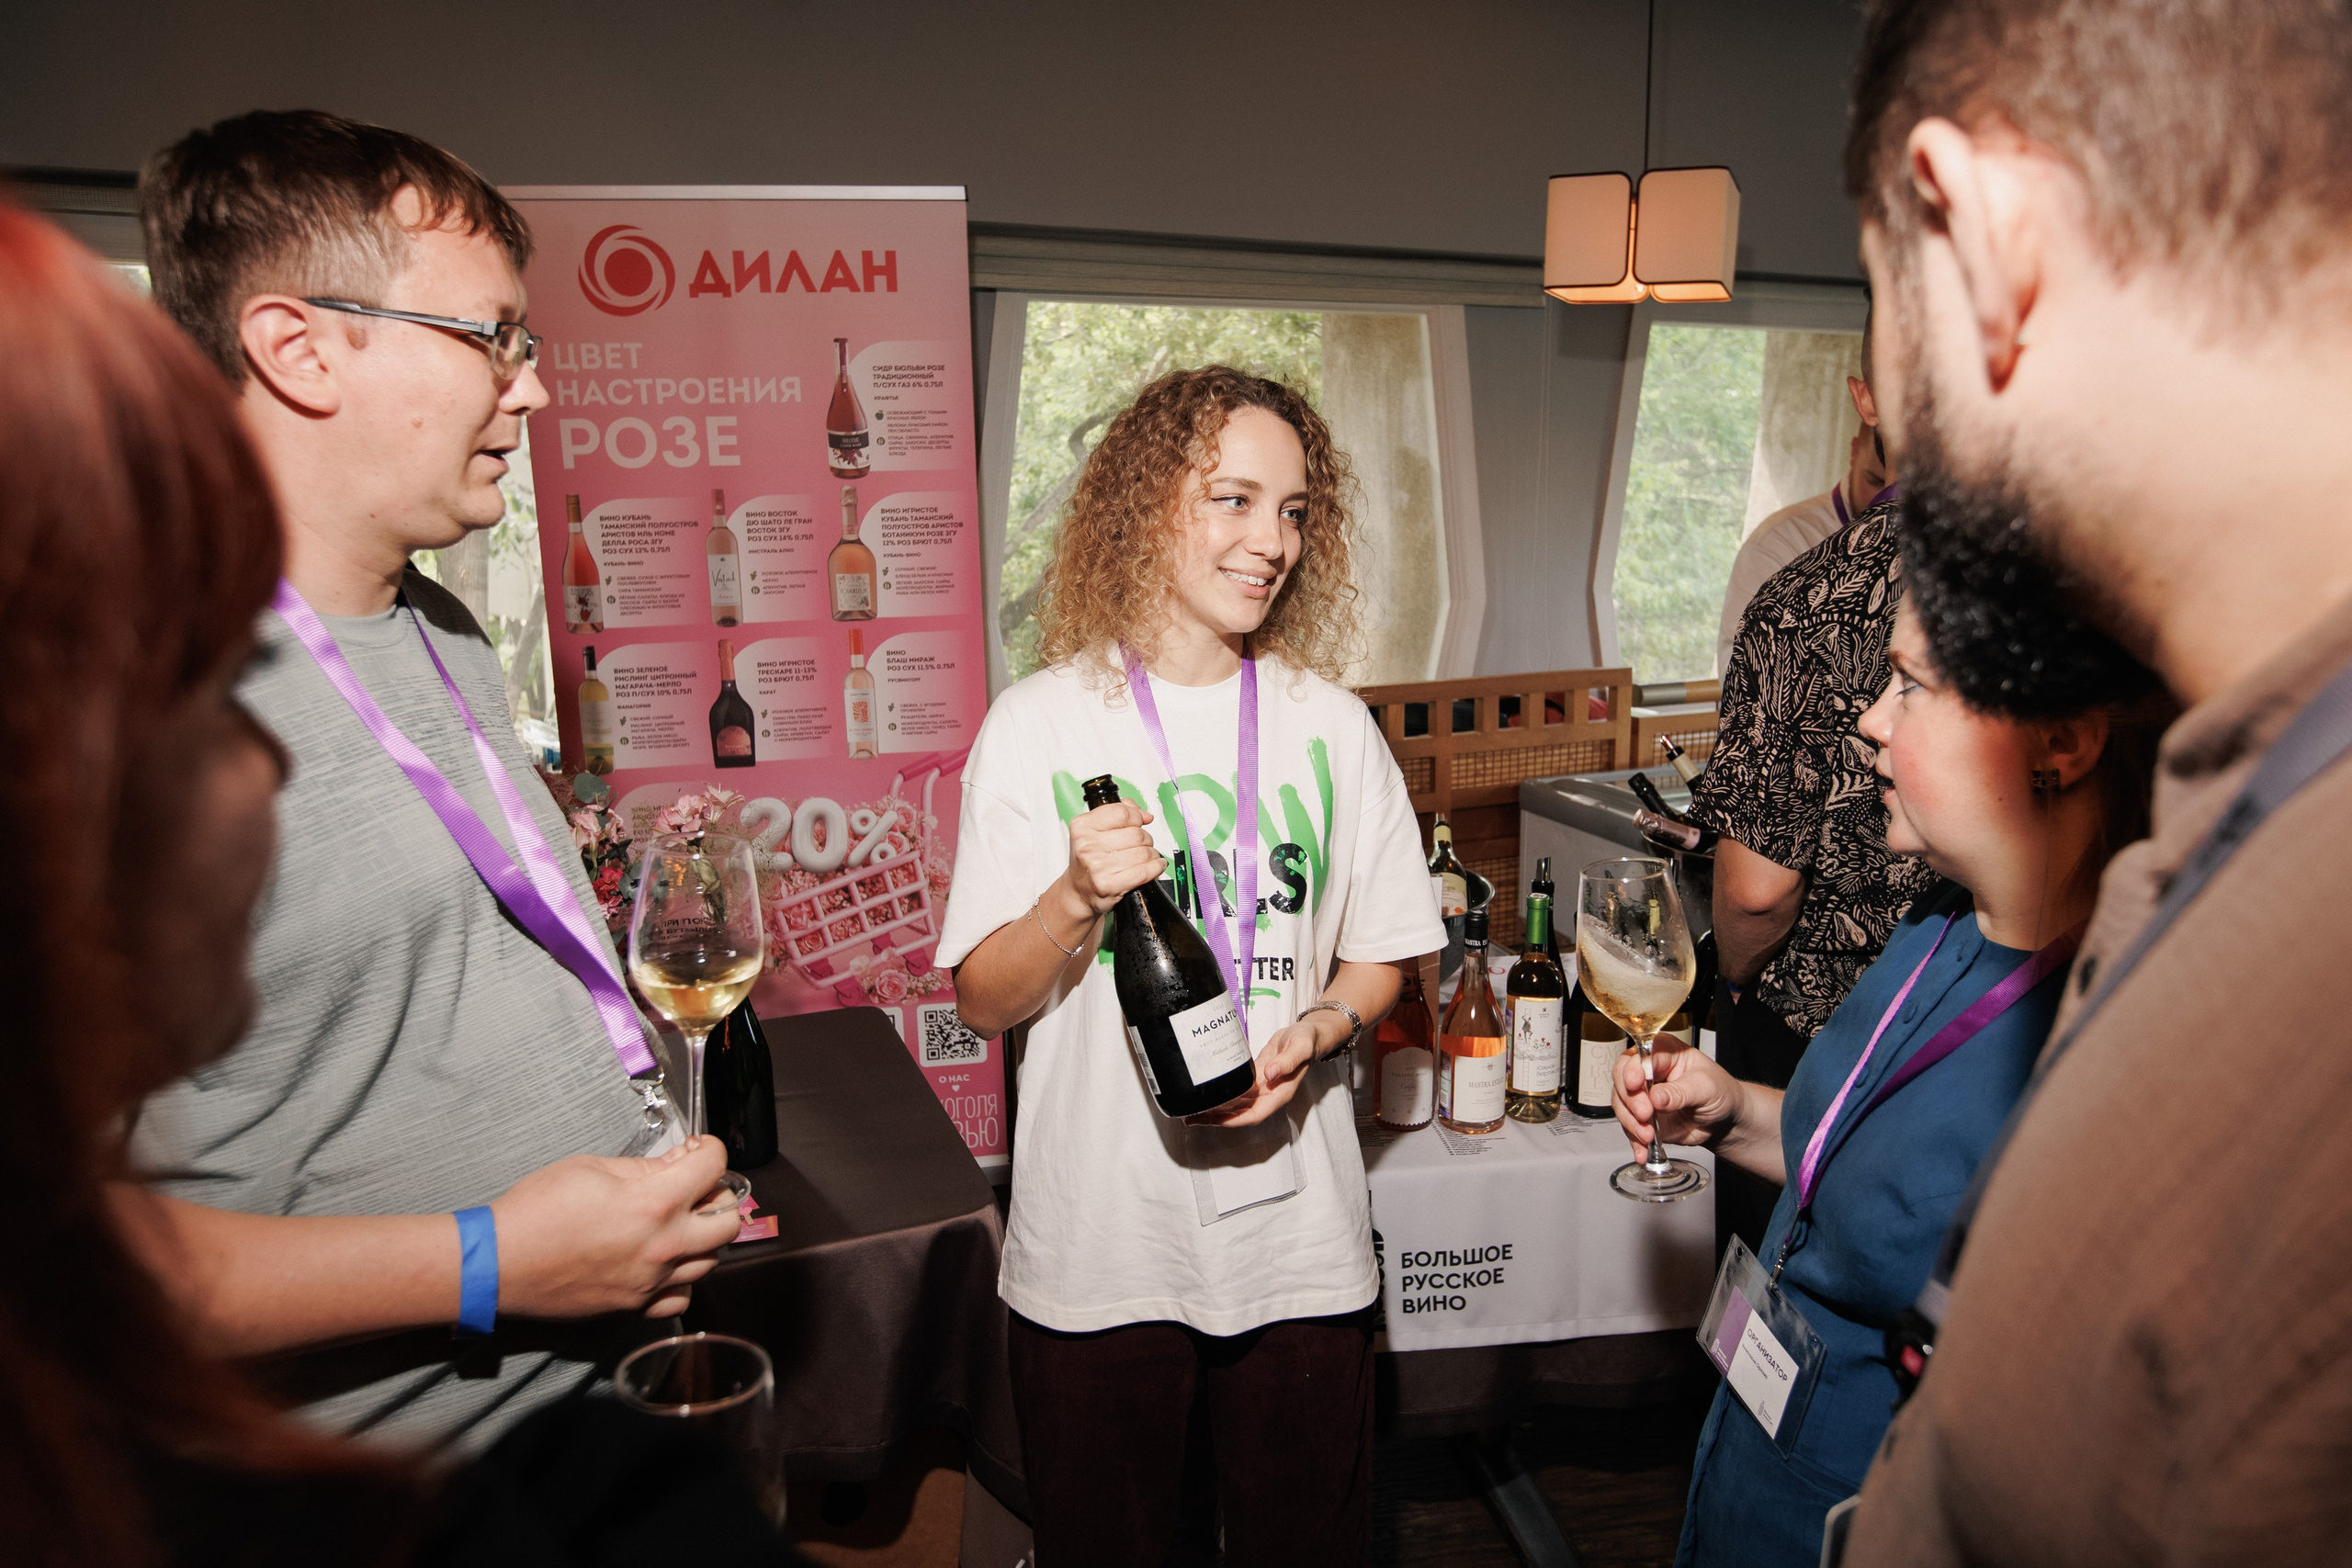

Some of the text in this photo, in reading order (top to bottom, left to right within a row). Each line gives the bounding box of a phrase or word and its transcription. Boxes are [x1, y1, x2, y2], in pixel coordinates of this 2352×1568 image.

[689, 250, 899, 299] ДИЛАН
[553, 342, 643, 373] ЦВЕТ
[873, 372, 933, 380] ТРАДИЦИОННЫЙ
[556, 377, 802, 406] НАСТРОЕНИЯ
[559, 415, 741, 469] РОЗЕ
[650, 671, 696, 681] ЦИТРОННЫЙ
[725, 797, 898, 872] 20%
[1234, 957, 1294, 981] TER
[939, 1074, 970, 1084] О НАС
[940, 1094, 998, 1121] ОГОЛЯ
[953, 1117, 999, 1148] ВЬЮ
[1401, 1244, 1513, 1269] БОЛЬШОЕ
[1402, 1268, 1504, 1292] РУССКОЕ
[1402, 1295, 1466, 1314] ВИНО
[1747, 1328, 1788, 1382] ОРГАНИЗАТОР
